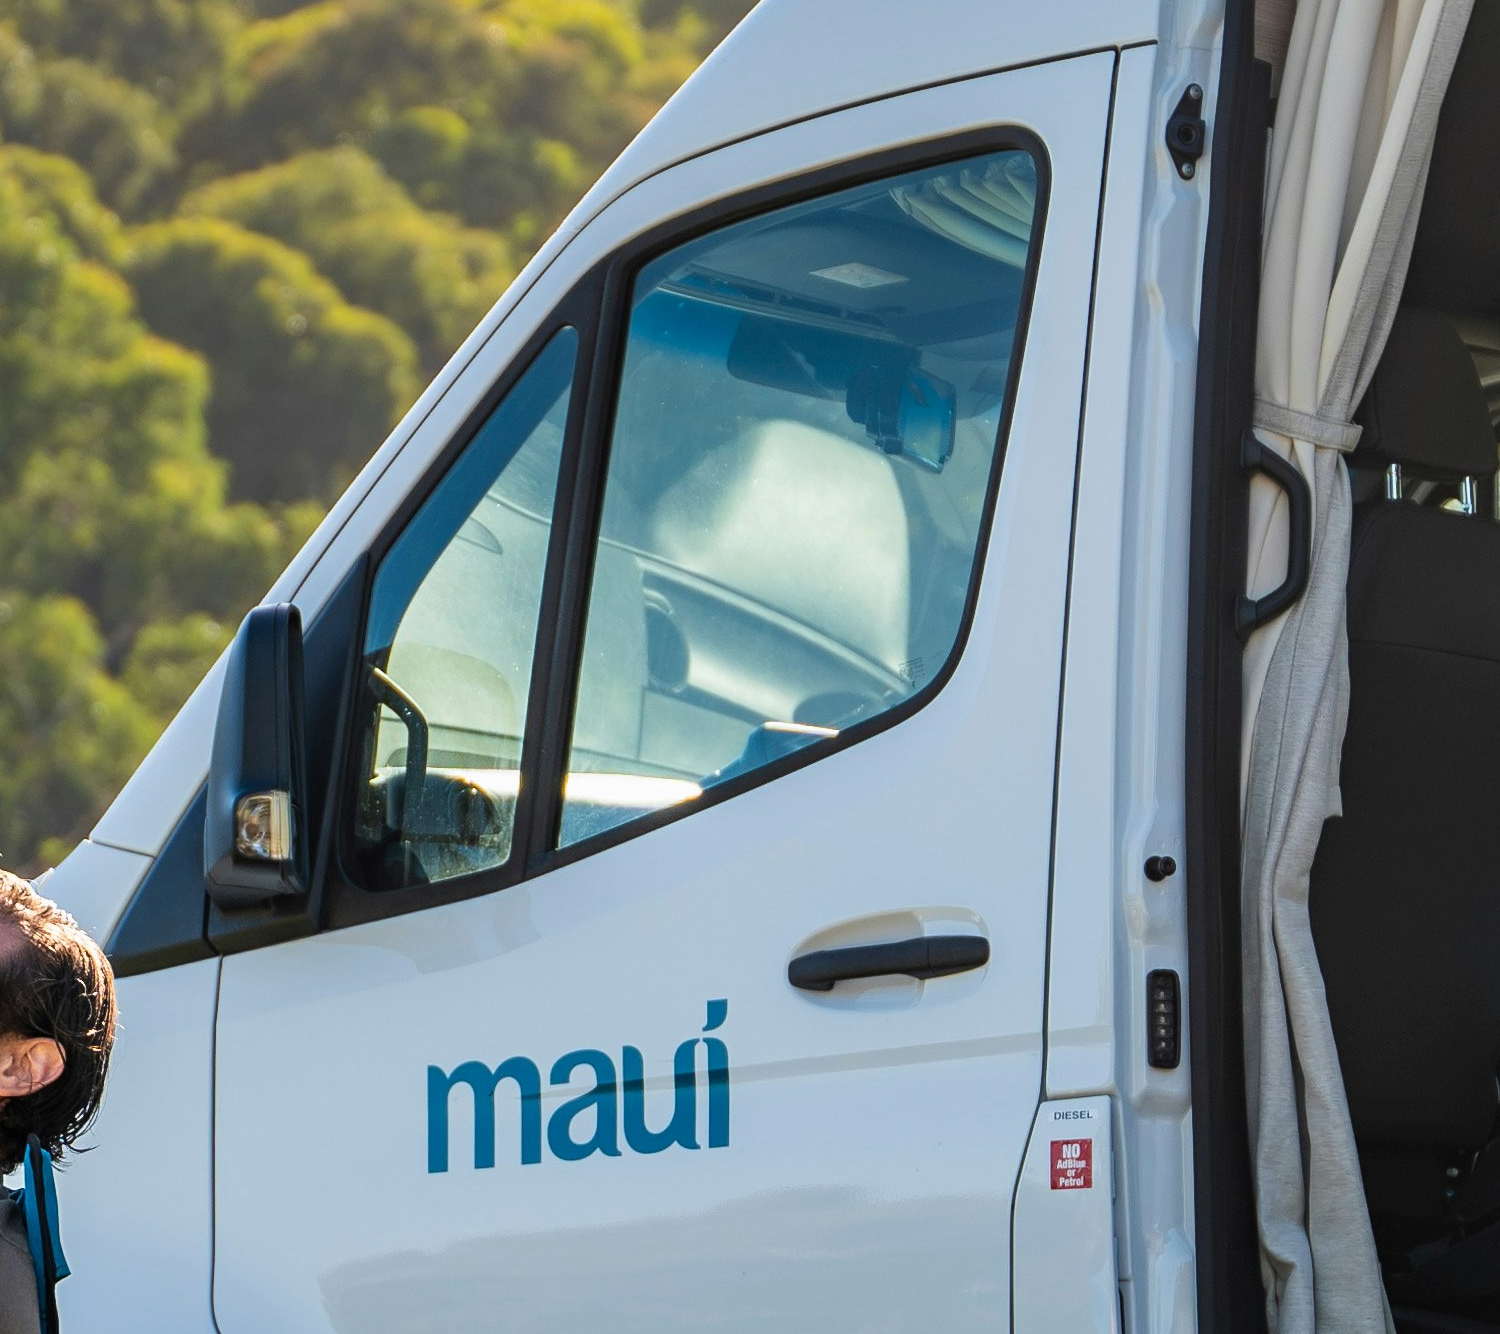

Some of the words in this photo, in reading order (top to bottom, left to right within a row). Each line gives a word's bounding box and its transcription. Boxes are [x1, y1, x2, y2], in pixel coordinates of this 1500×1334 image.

[1053, 1110, 1093, 1120] DIESEL
[1062, 1143, 1081, 1158] NO
[1056, 1159, 1087, 1169] AdBlue
[1066, 1169, 1076, 1177] or
[1059, 1176, 1084, 1187] Petrol
